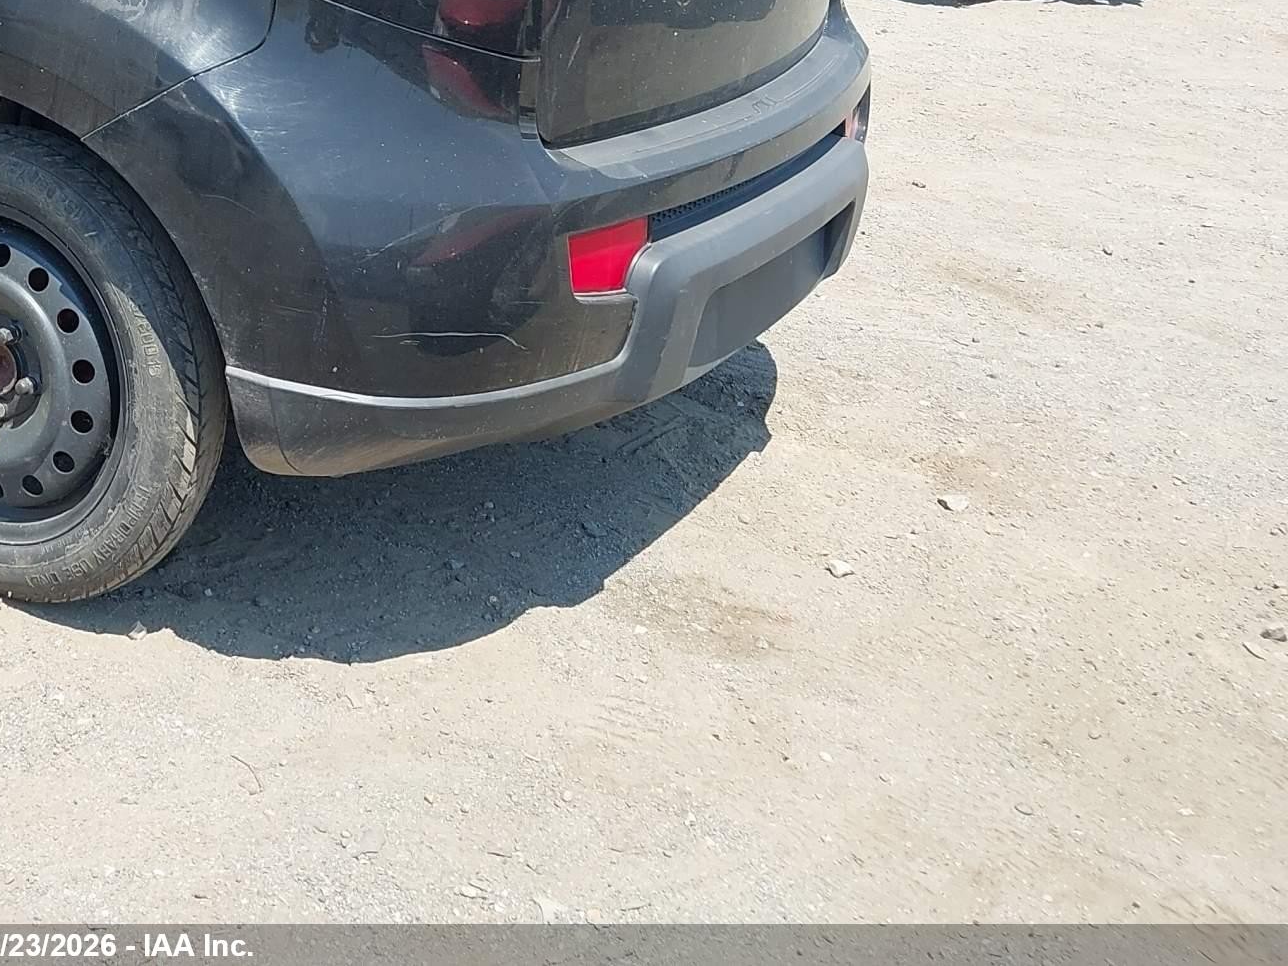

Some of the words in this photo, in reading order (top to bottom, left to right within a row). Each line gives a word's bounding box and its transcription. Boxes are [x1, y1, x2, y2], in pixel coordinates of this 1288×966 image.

[92, 485, 153, 564] TEMPORARY
[25, 572, 61, 587] ONLY
[62, 559, 93, 581] USE
